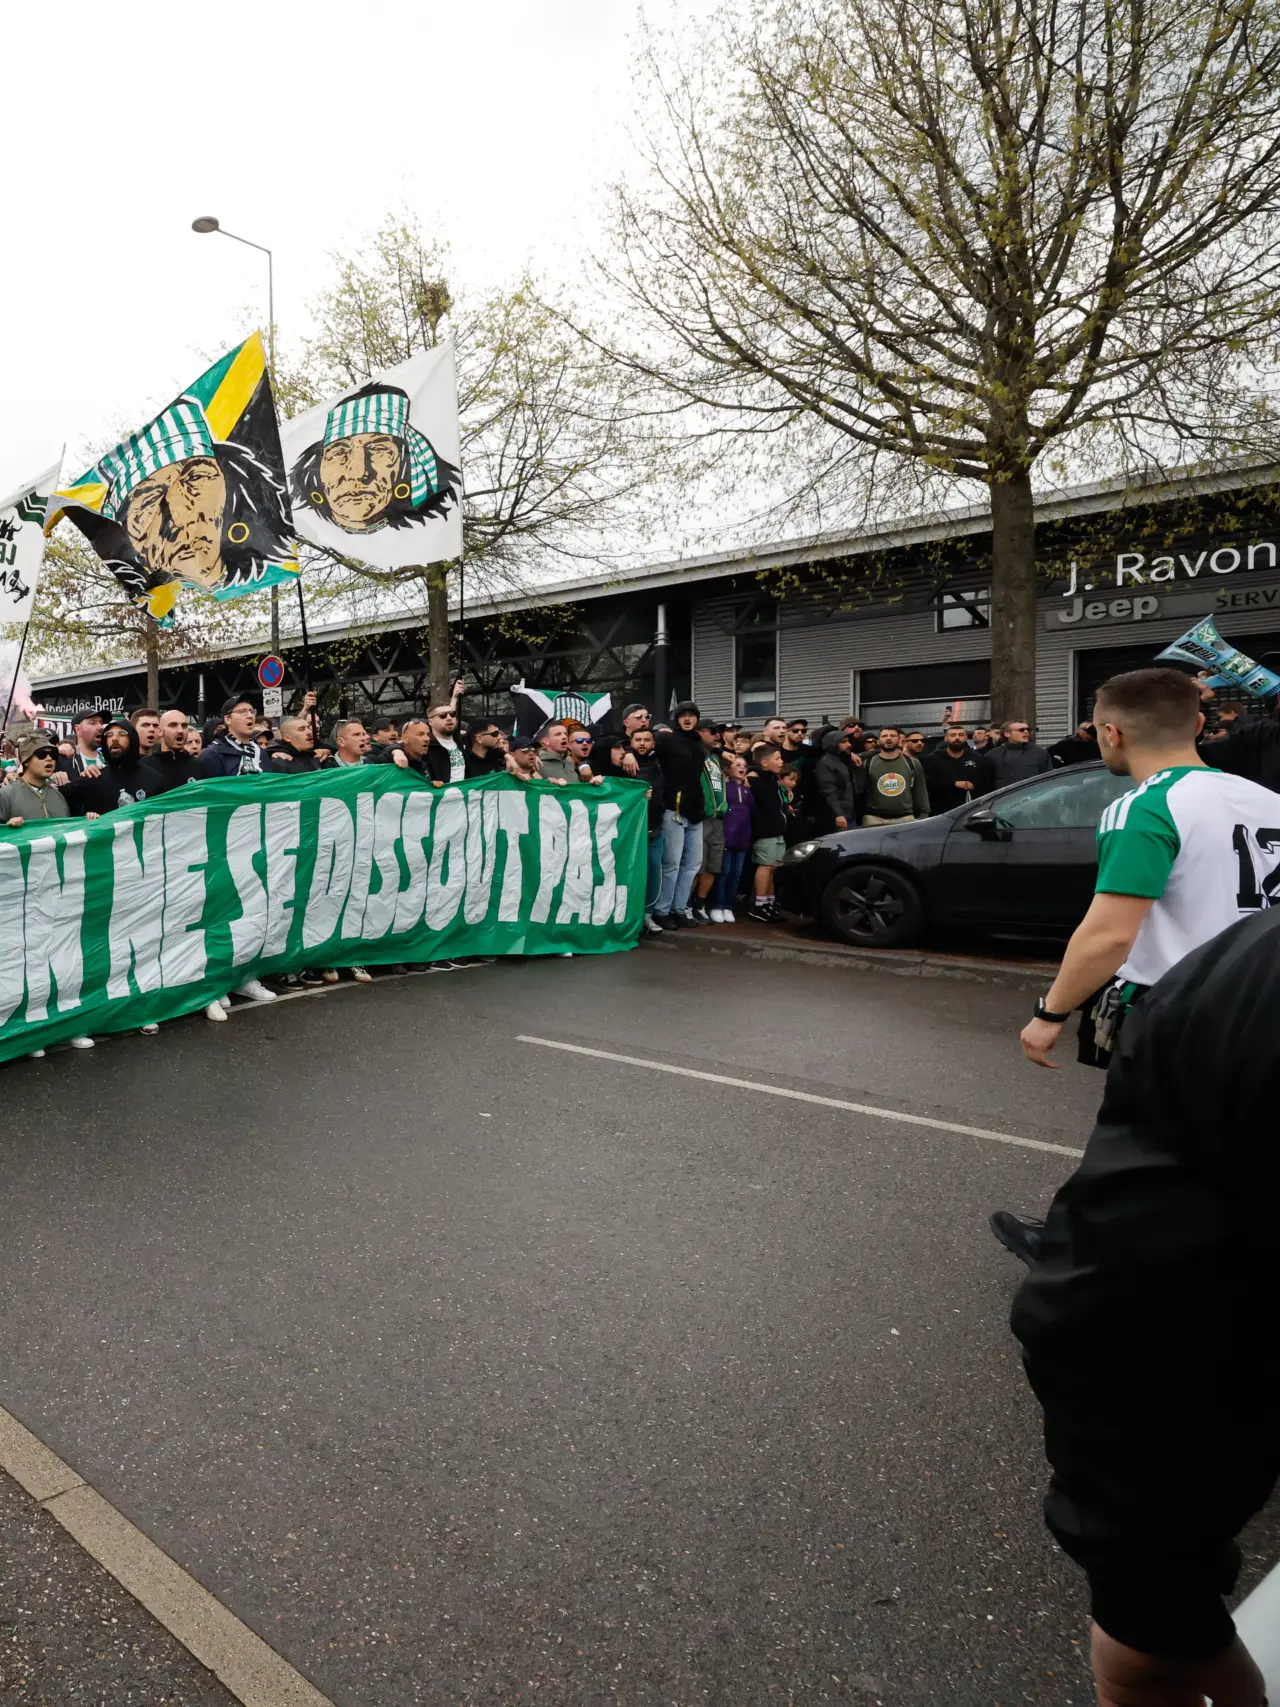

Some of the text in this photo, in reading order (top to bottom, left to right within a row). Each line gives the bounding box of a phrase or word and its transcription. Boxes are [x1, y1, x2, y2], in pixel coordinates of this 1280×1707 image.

[1062, 541, 1277, 597] J. Ravon
[1057, 588, 1279, 623] Jeep SERV
[106, 807, 208, 1000] NE
[228, 801, 300, 966] SE
[303, 789, 529, 948] DISSOUT
